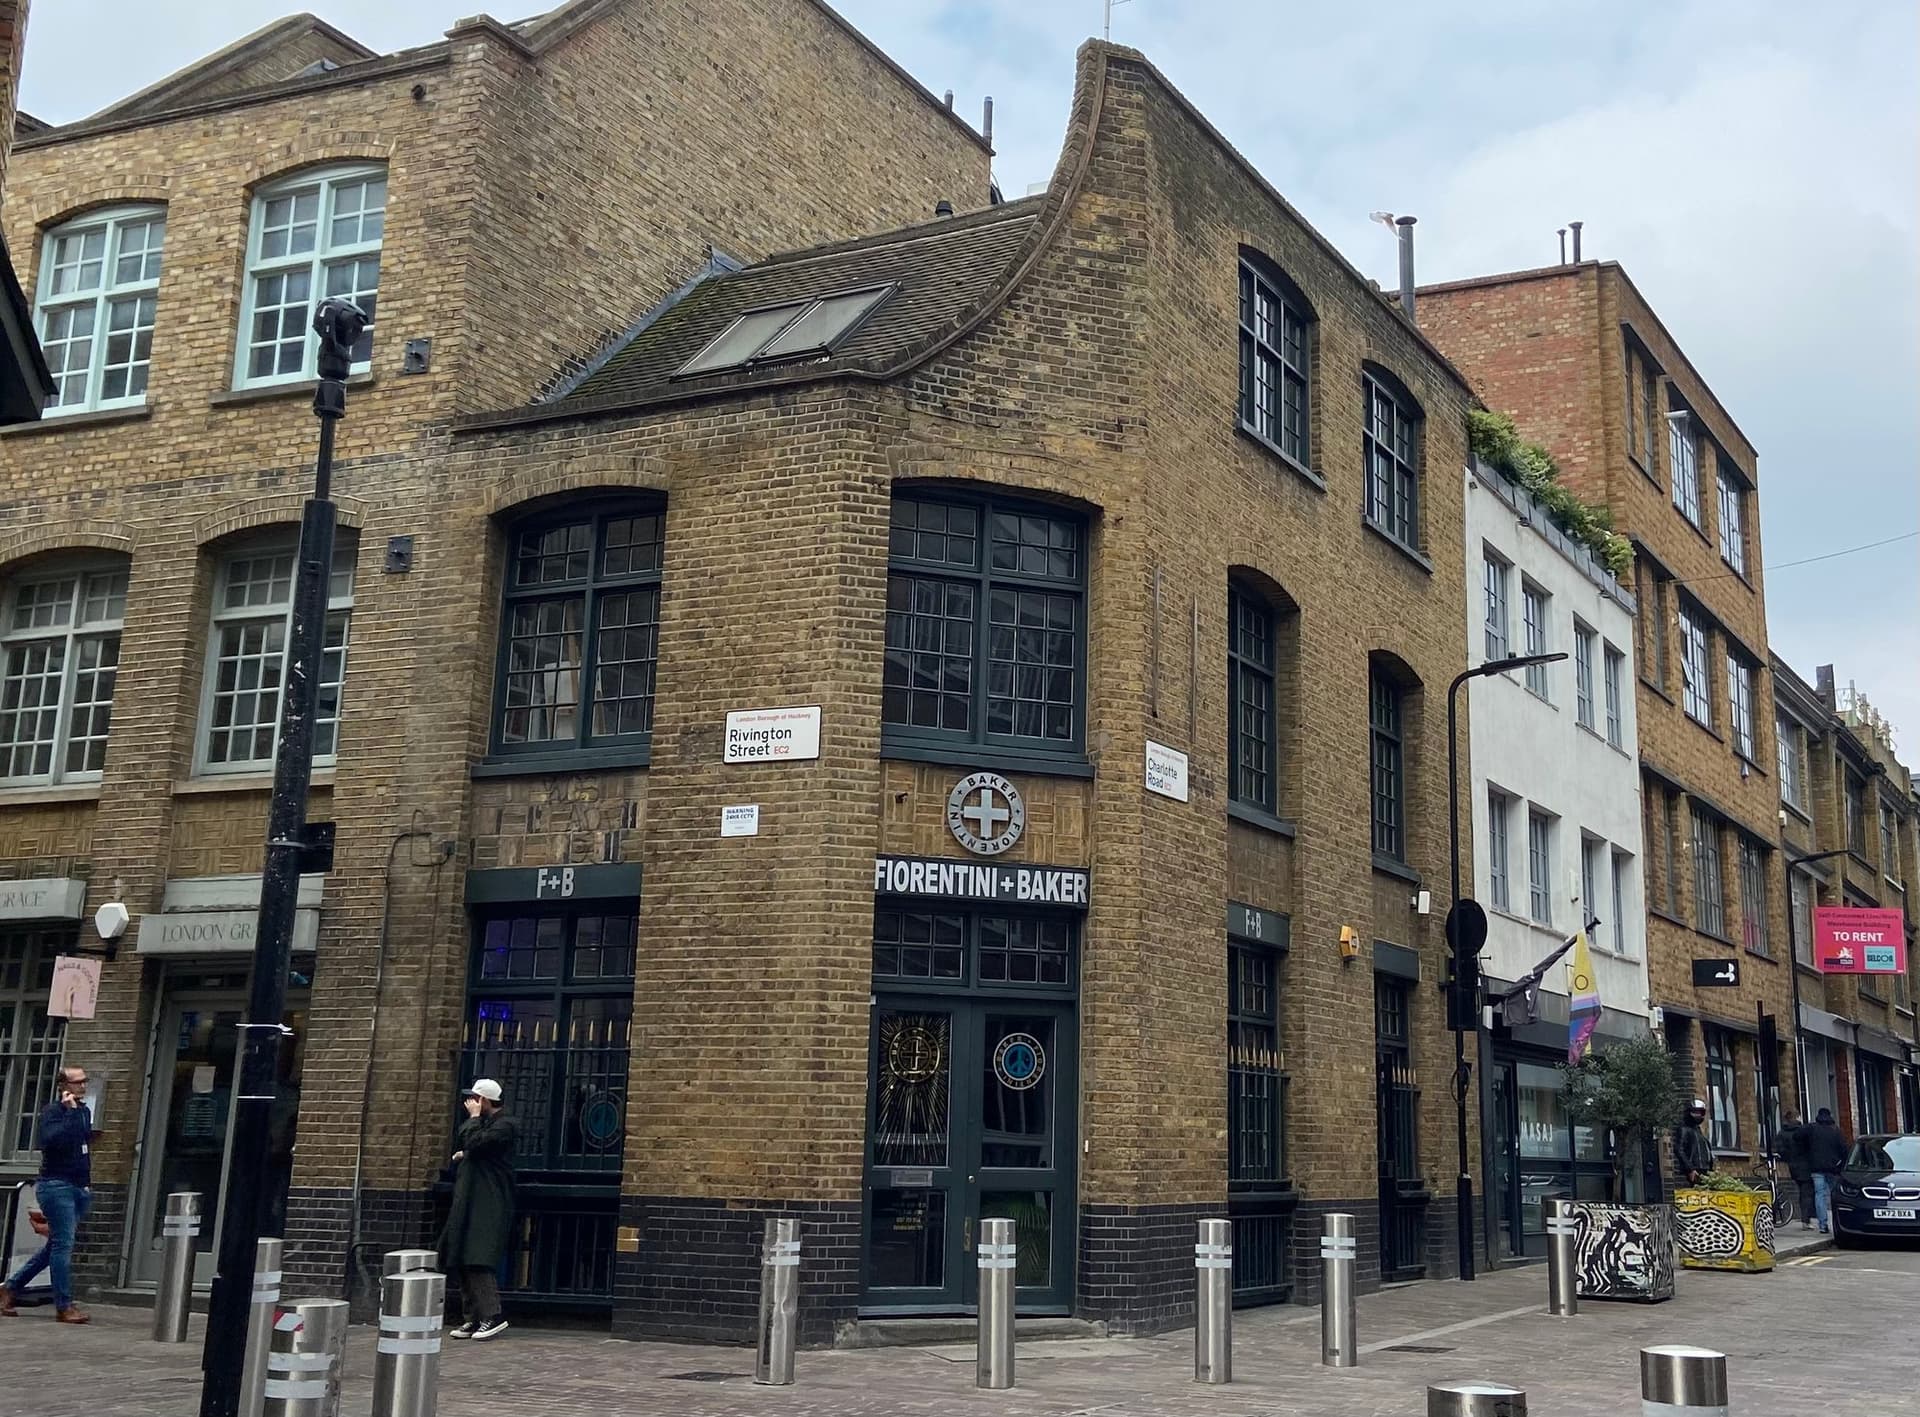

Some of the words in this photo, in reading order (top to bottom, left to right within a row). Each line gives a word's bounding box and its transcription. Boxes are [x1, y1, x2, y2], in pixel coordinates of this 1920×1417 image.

[729, 727, 792, 743] Rivington
[729, 743, 770, 757] Street
[774, 746, 790, 754] EC2
[1148, 757, 1178, 780] Charlotte
[967, 775, 1017, 801] BAKER
[1148, 772, 1164, 788] Road
[950, 803, 1021, 852] FIORENTINI
[874, 859, 997, 898] FIORENTINI
[1017, 869, 1087, 903] BAKER
[162, 923, 223, 943] LONDON
[1833, 931, 1850, 942] TO
[1852, 931, 1884, 943] RENT
[1520, 1121, 1553, 1142] MASAJ
